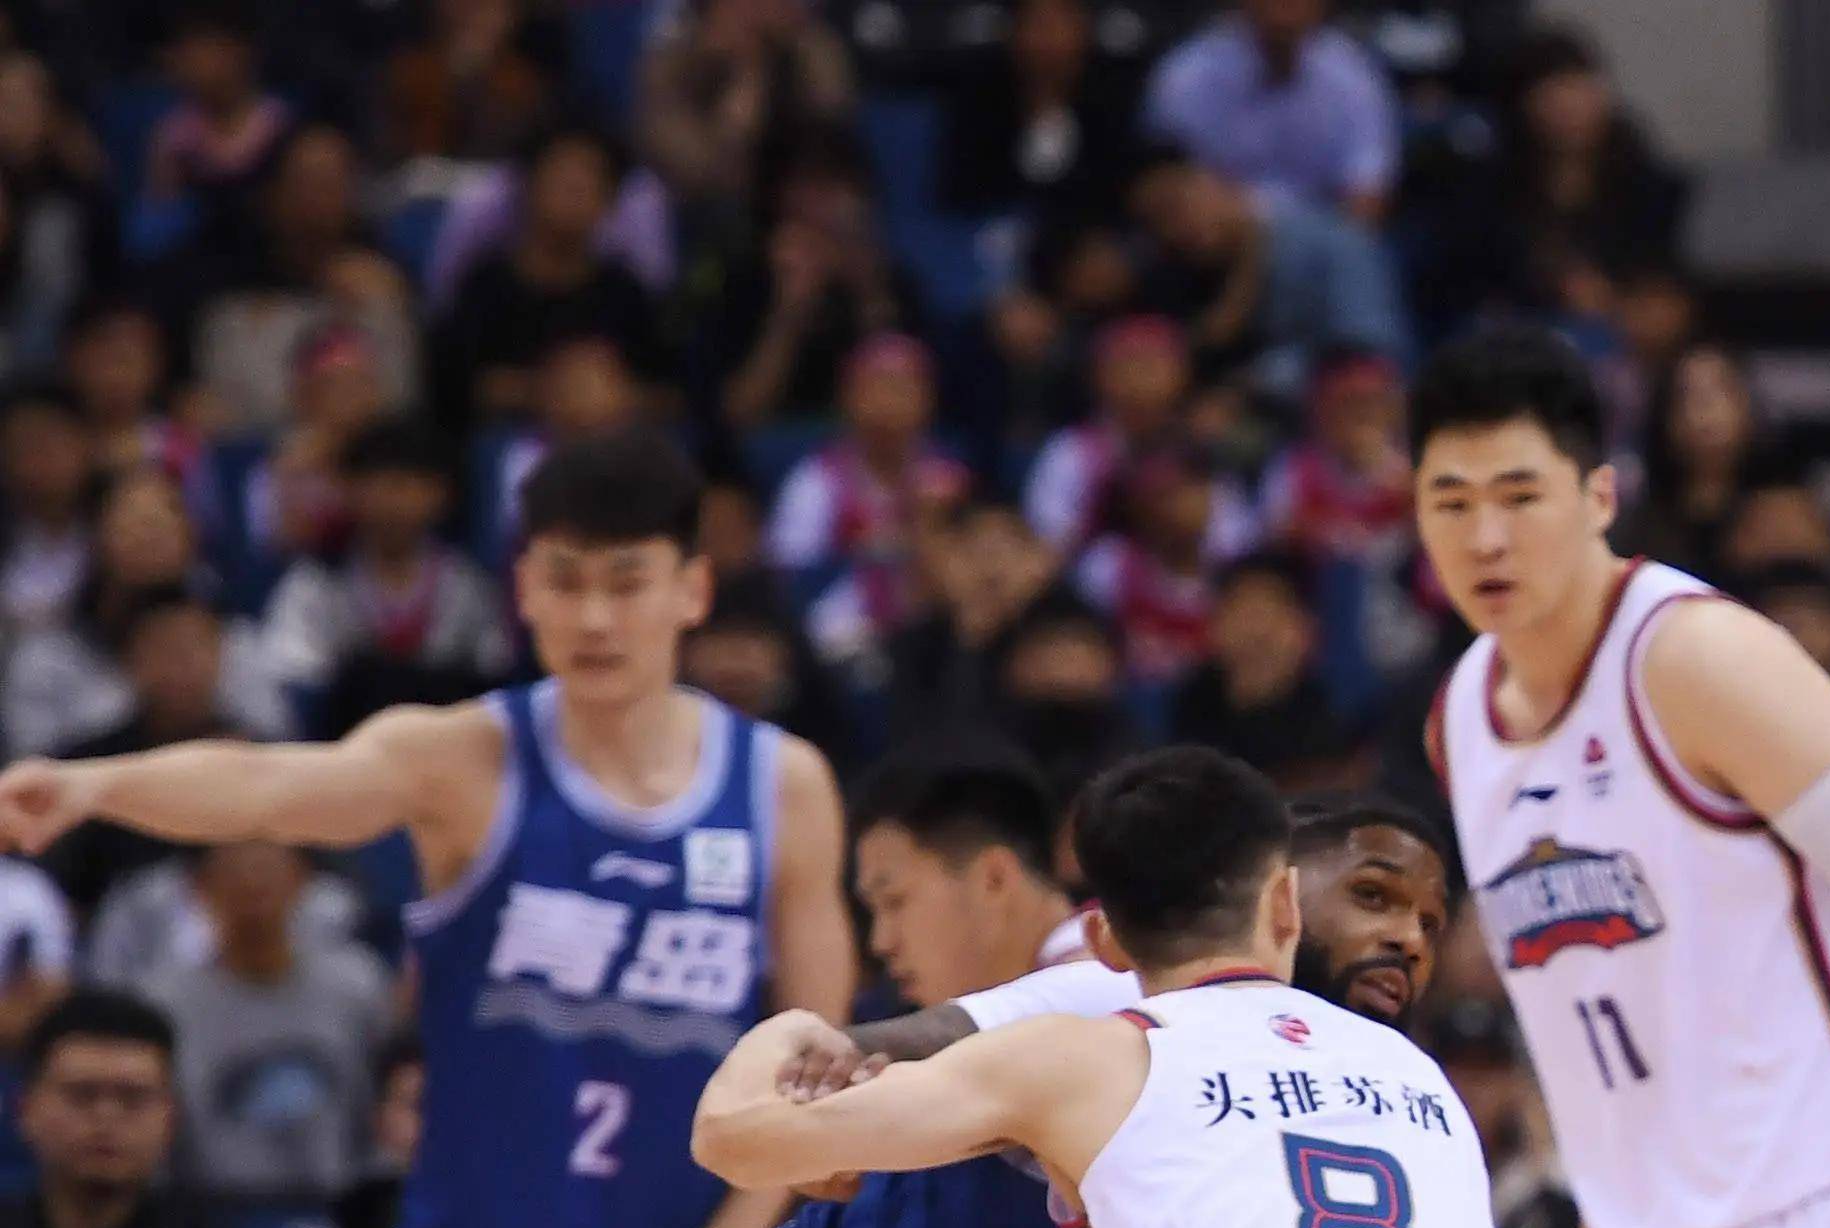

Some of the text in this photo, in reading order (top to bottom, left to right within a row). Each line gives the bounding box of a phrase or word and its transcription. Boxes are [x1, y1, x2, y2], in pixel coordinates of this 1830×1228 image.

[488, 881, 755, 1014] 青岛
[1575, 996, 1651, 1089] 11
[568, 1080, 632, 1177] 2
[1196, 1071, 1452, 1137] 头排苏酒
